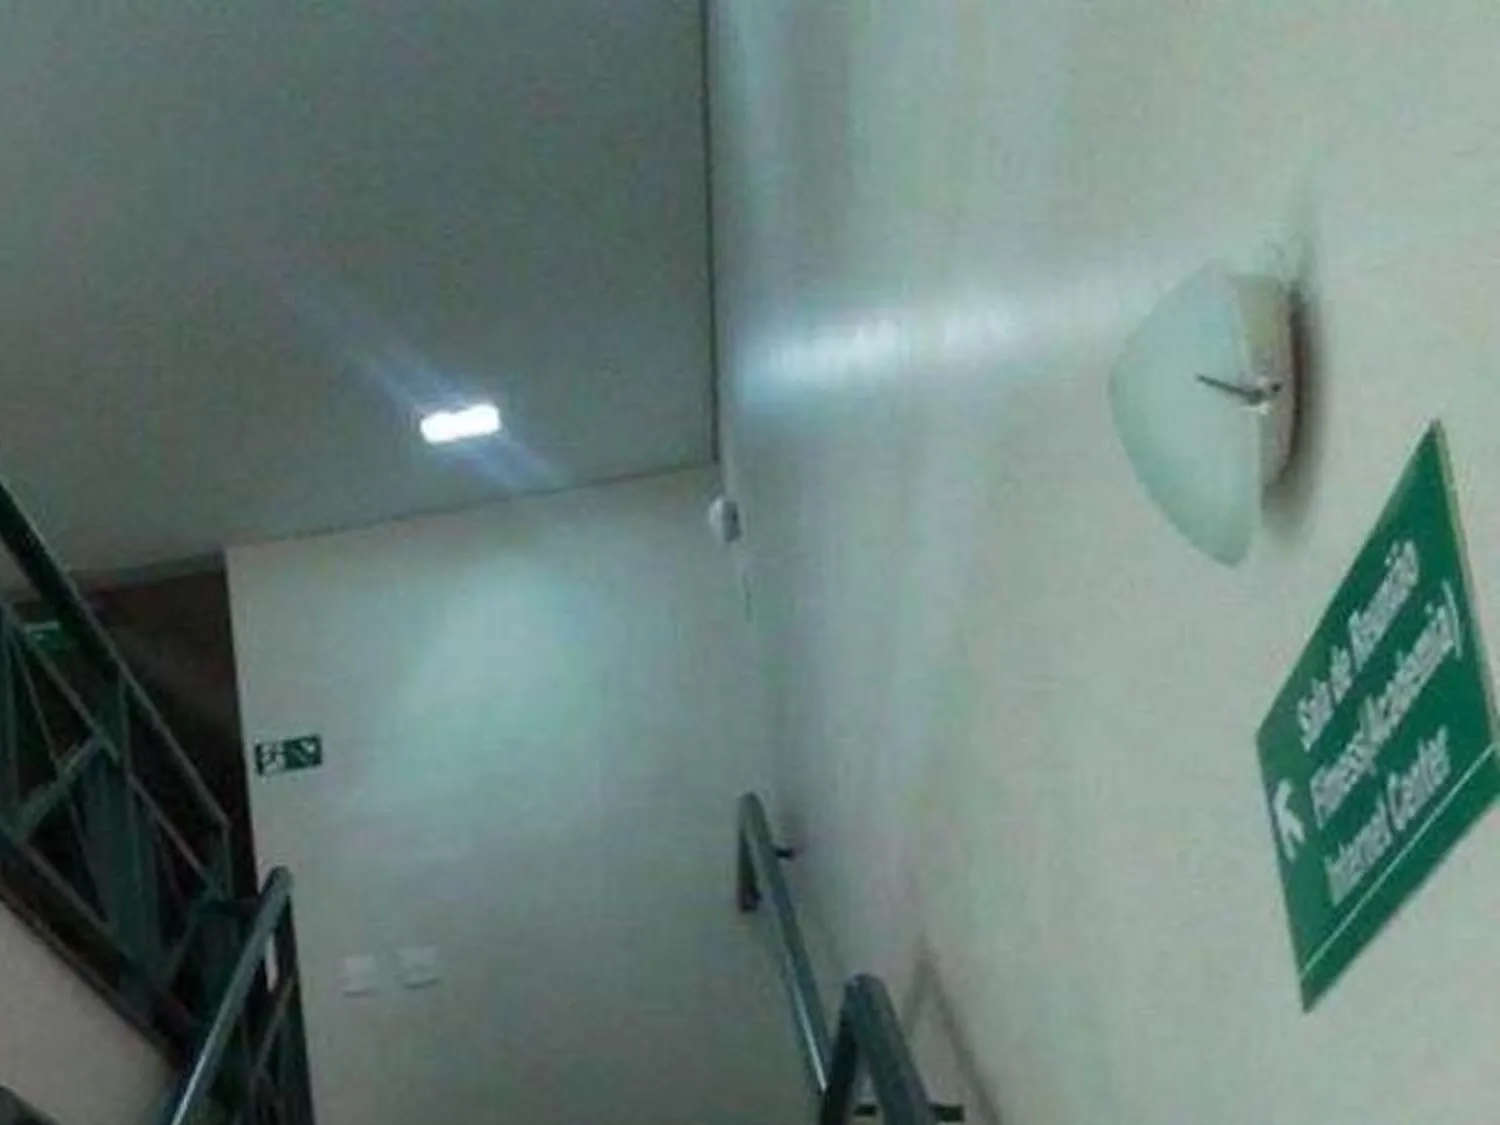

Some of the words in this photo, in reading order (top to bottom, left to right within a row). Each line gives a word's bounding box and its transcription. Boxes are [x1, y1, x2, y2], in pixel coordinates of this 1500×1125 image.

[1298, 680, 1333, 751] Sala
[1331, 647, 1352, 702] de
[1348, 540, 1418, 671] Reunião
[1326, 800, 1391, 904] Internet
[1388, 728, 1448, 830] Center
